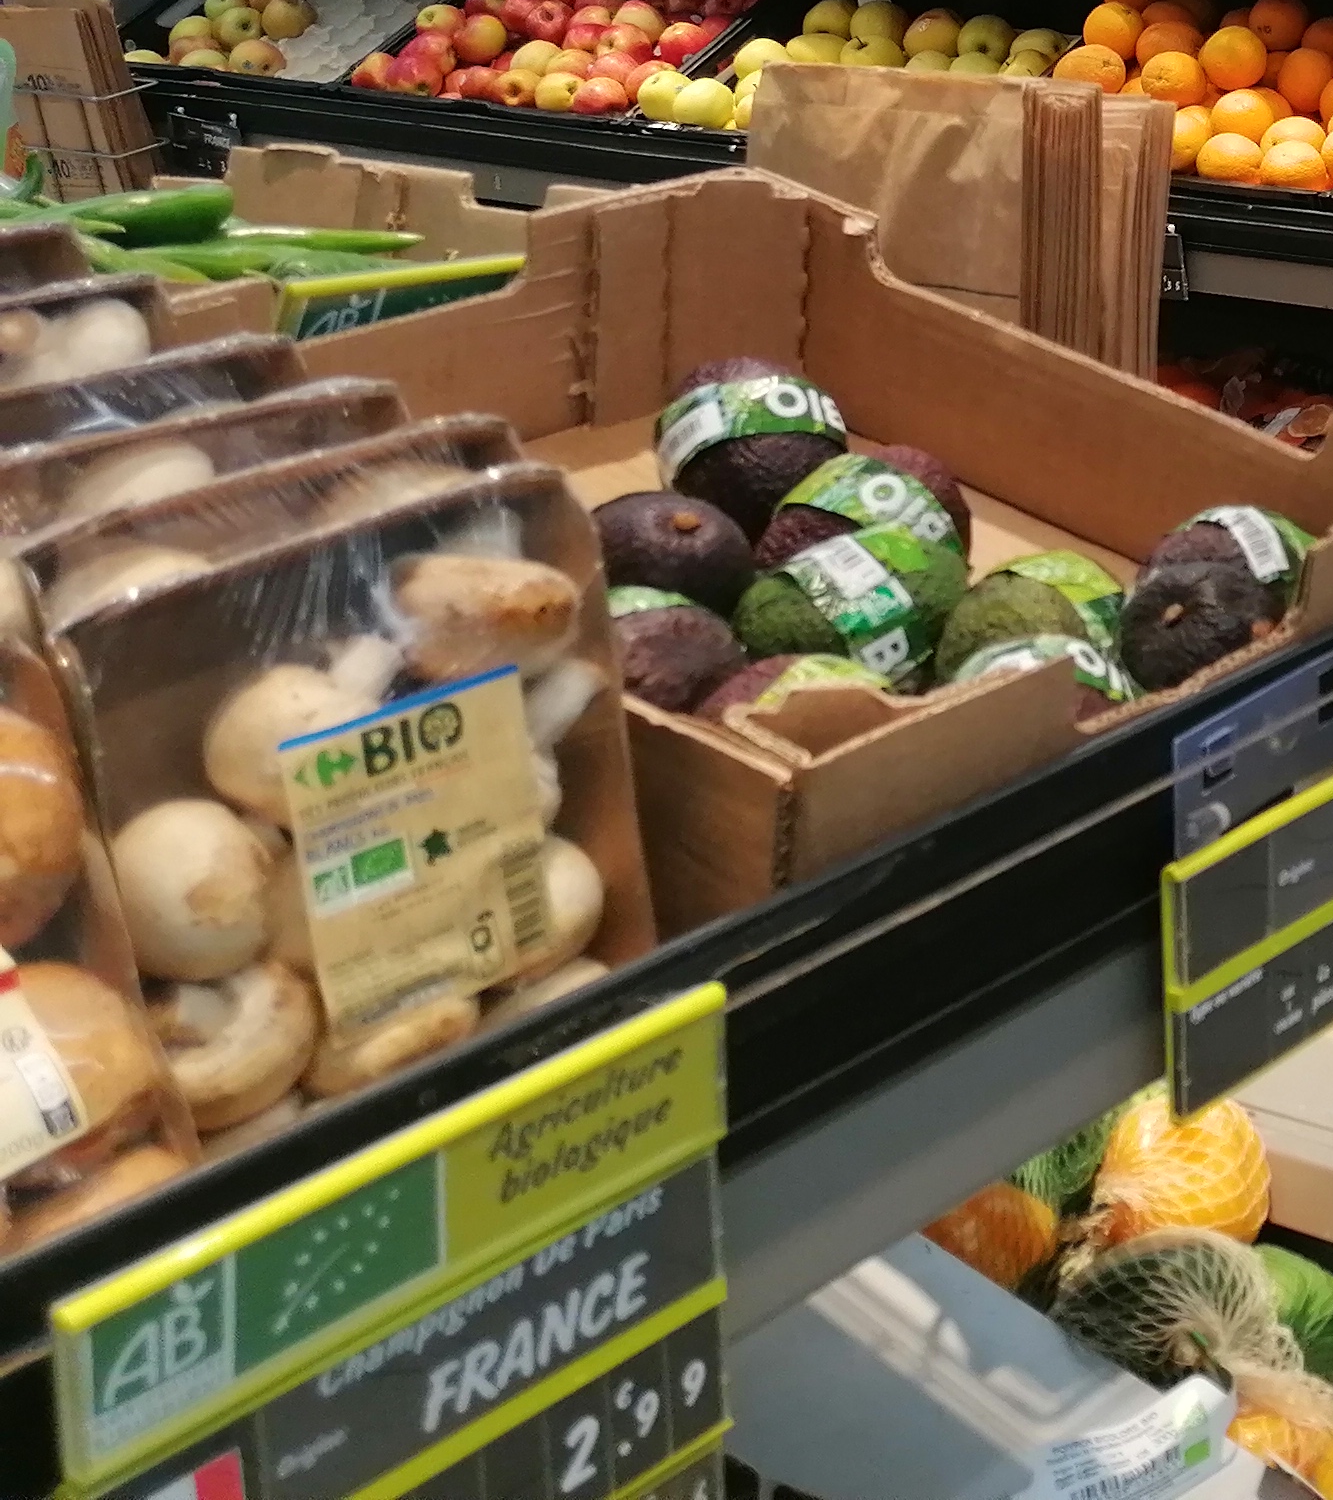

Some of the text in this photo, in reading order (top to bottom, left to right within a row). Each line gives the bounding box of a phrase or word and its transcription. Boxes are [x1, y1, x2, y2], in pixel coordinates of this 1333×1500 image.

[360, 702, 464, 779] BIO
[489, 1046, 684, 1164] Agriculture
[500, 1095, 672, 1205] biologique
[102, 1308, 208, 1408] AB
[317, 1255, 525, 1400] Champignon
[422, 1250, 652, 1435] FRANCE
